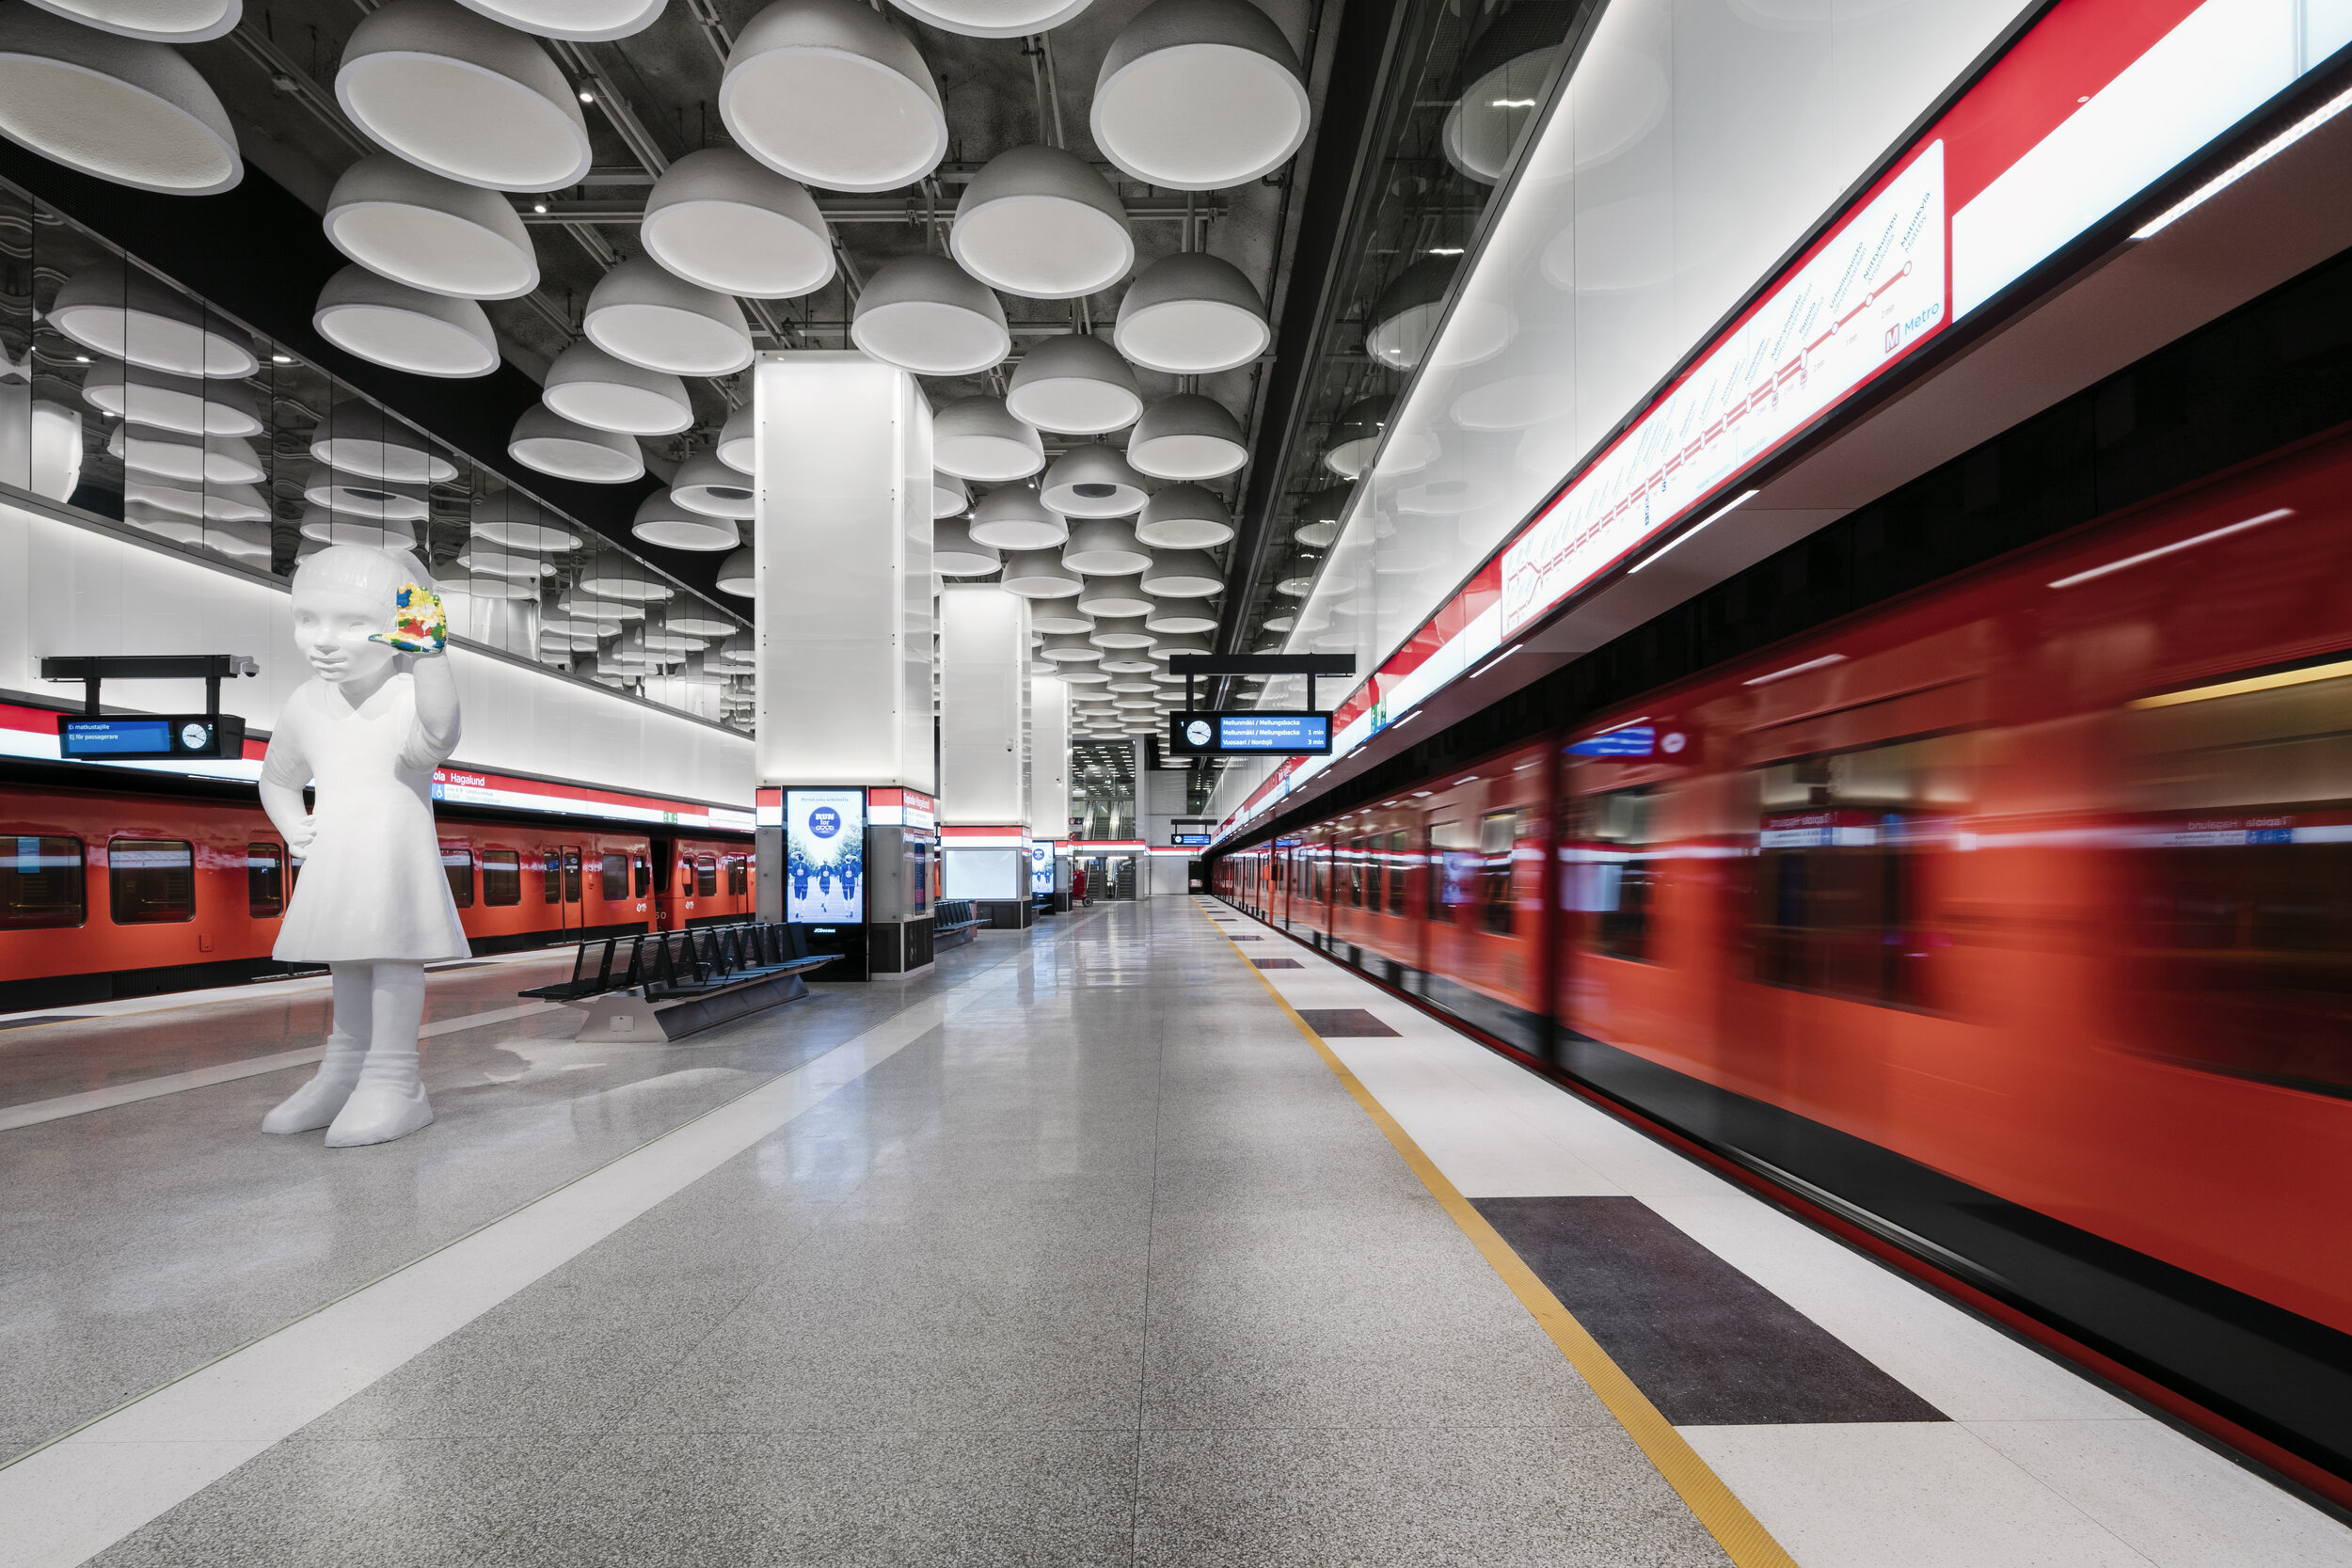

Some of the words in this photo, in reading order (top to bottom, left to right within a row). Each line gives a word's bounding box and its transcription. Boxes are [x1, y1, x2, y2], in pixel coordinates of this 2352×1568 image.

[1864, 213, 1899, 280] Niittykumpu
[1829, 242, 1864, 309] Urheilupuisto
[1904, 302, 1940, 336] Metro
[450, 772, 485, 786] Hagalund
